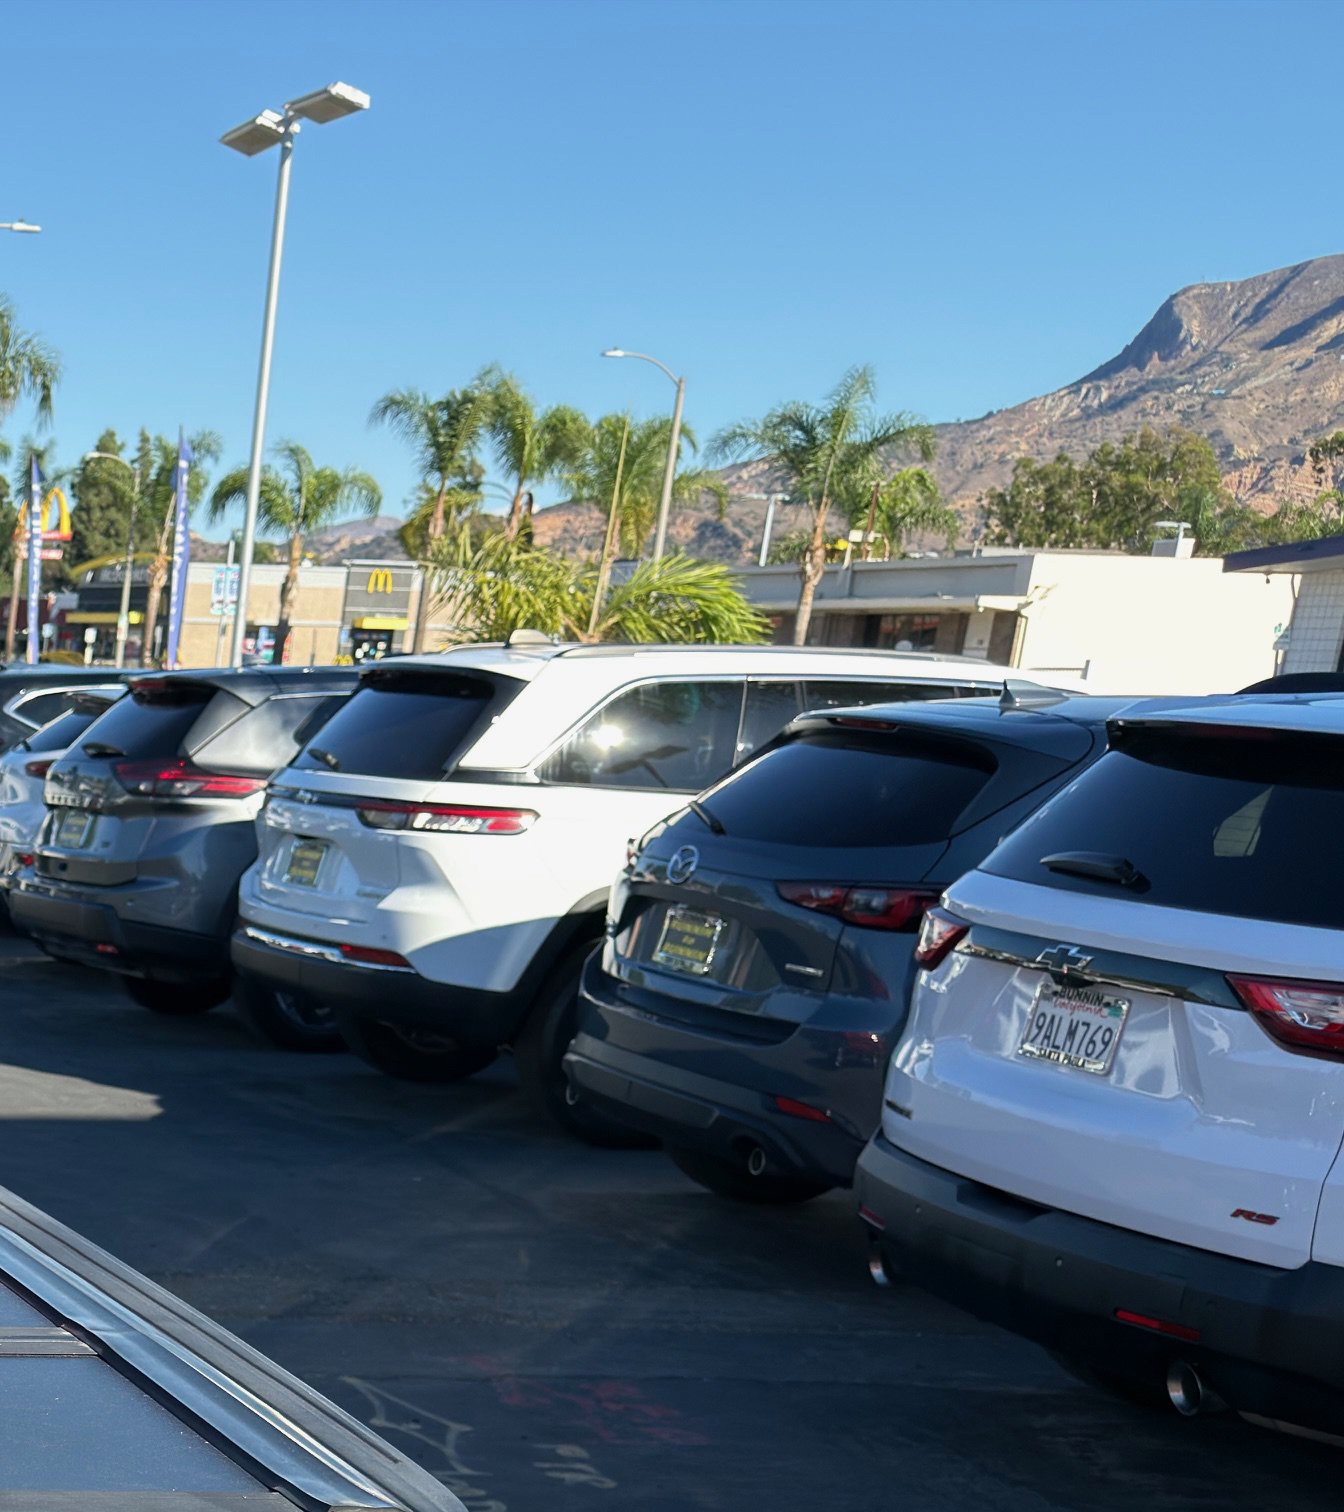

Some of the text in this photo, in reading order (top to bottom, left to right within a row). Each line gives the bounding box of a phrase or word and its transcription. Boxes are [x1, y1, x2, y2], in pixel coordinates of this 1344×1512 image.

[1058, 985, 1105, 1006] BUNNIN
[1030, 1012, 1114, 1060] 9ALM769
[1230, 1208, 1280, 1226] RS
